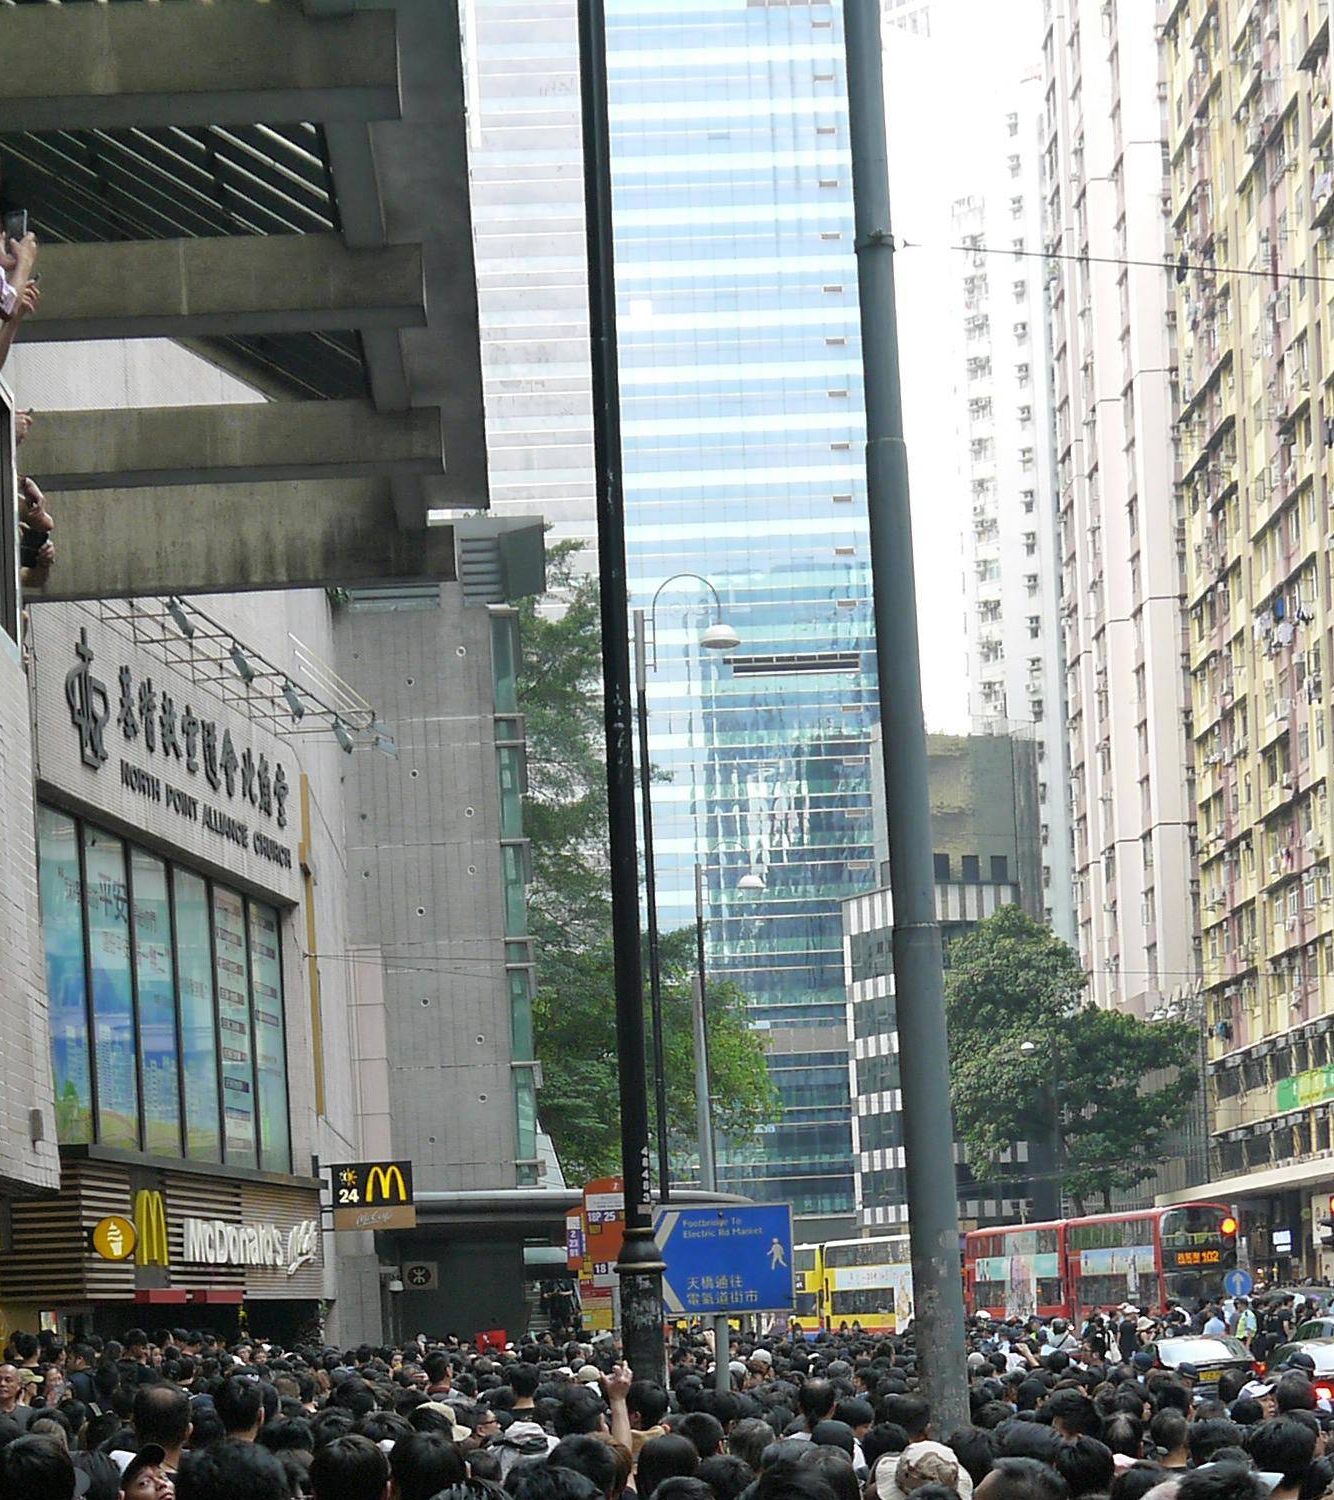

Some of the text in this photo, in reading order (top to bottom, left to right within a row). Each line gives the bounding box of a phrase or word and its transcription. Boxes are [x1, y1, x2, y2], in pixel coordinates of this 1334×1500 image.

[120, 758, 292, 869] NORTH POINT ALLIANCE CHURCH
[339, 1188, 360, 1204] 24
[603, 1211, 616, 1222] 25
[682, 1217, 743, 1230] Footbridge To
[683, 1227, 764, 1240] Electric Rd Market
[183, 1218, 284, 1266] McDonald's
[1201, 1250, 1220, 1263] 102
[594, 1264, 607, 1274] 18
[687, 1274, 744, 1291] 天橋通往
[686, 1290, 759, 1305] 電氣道街市
